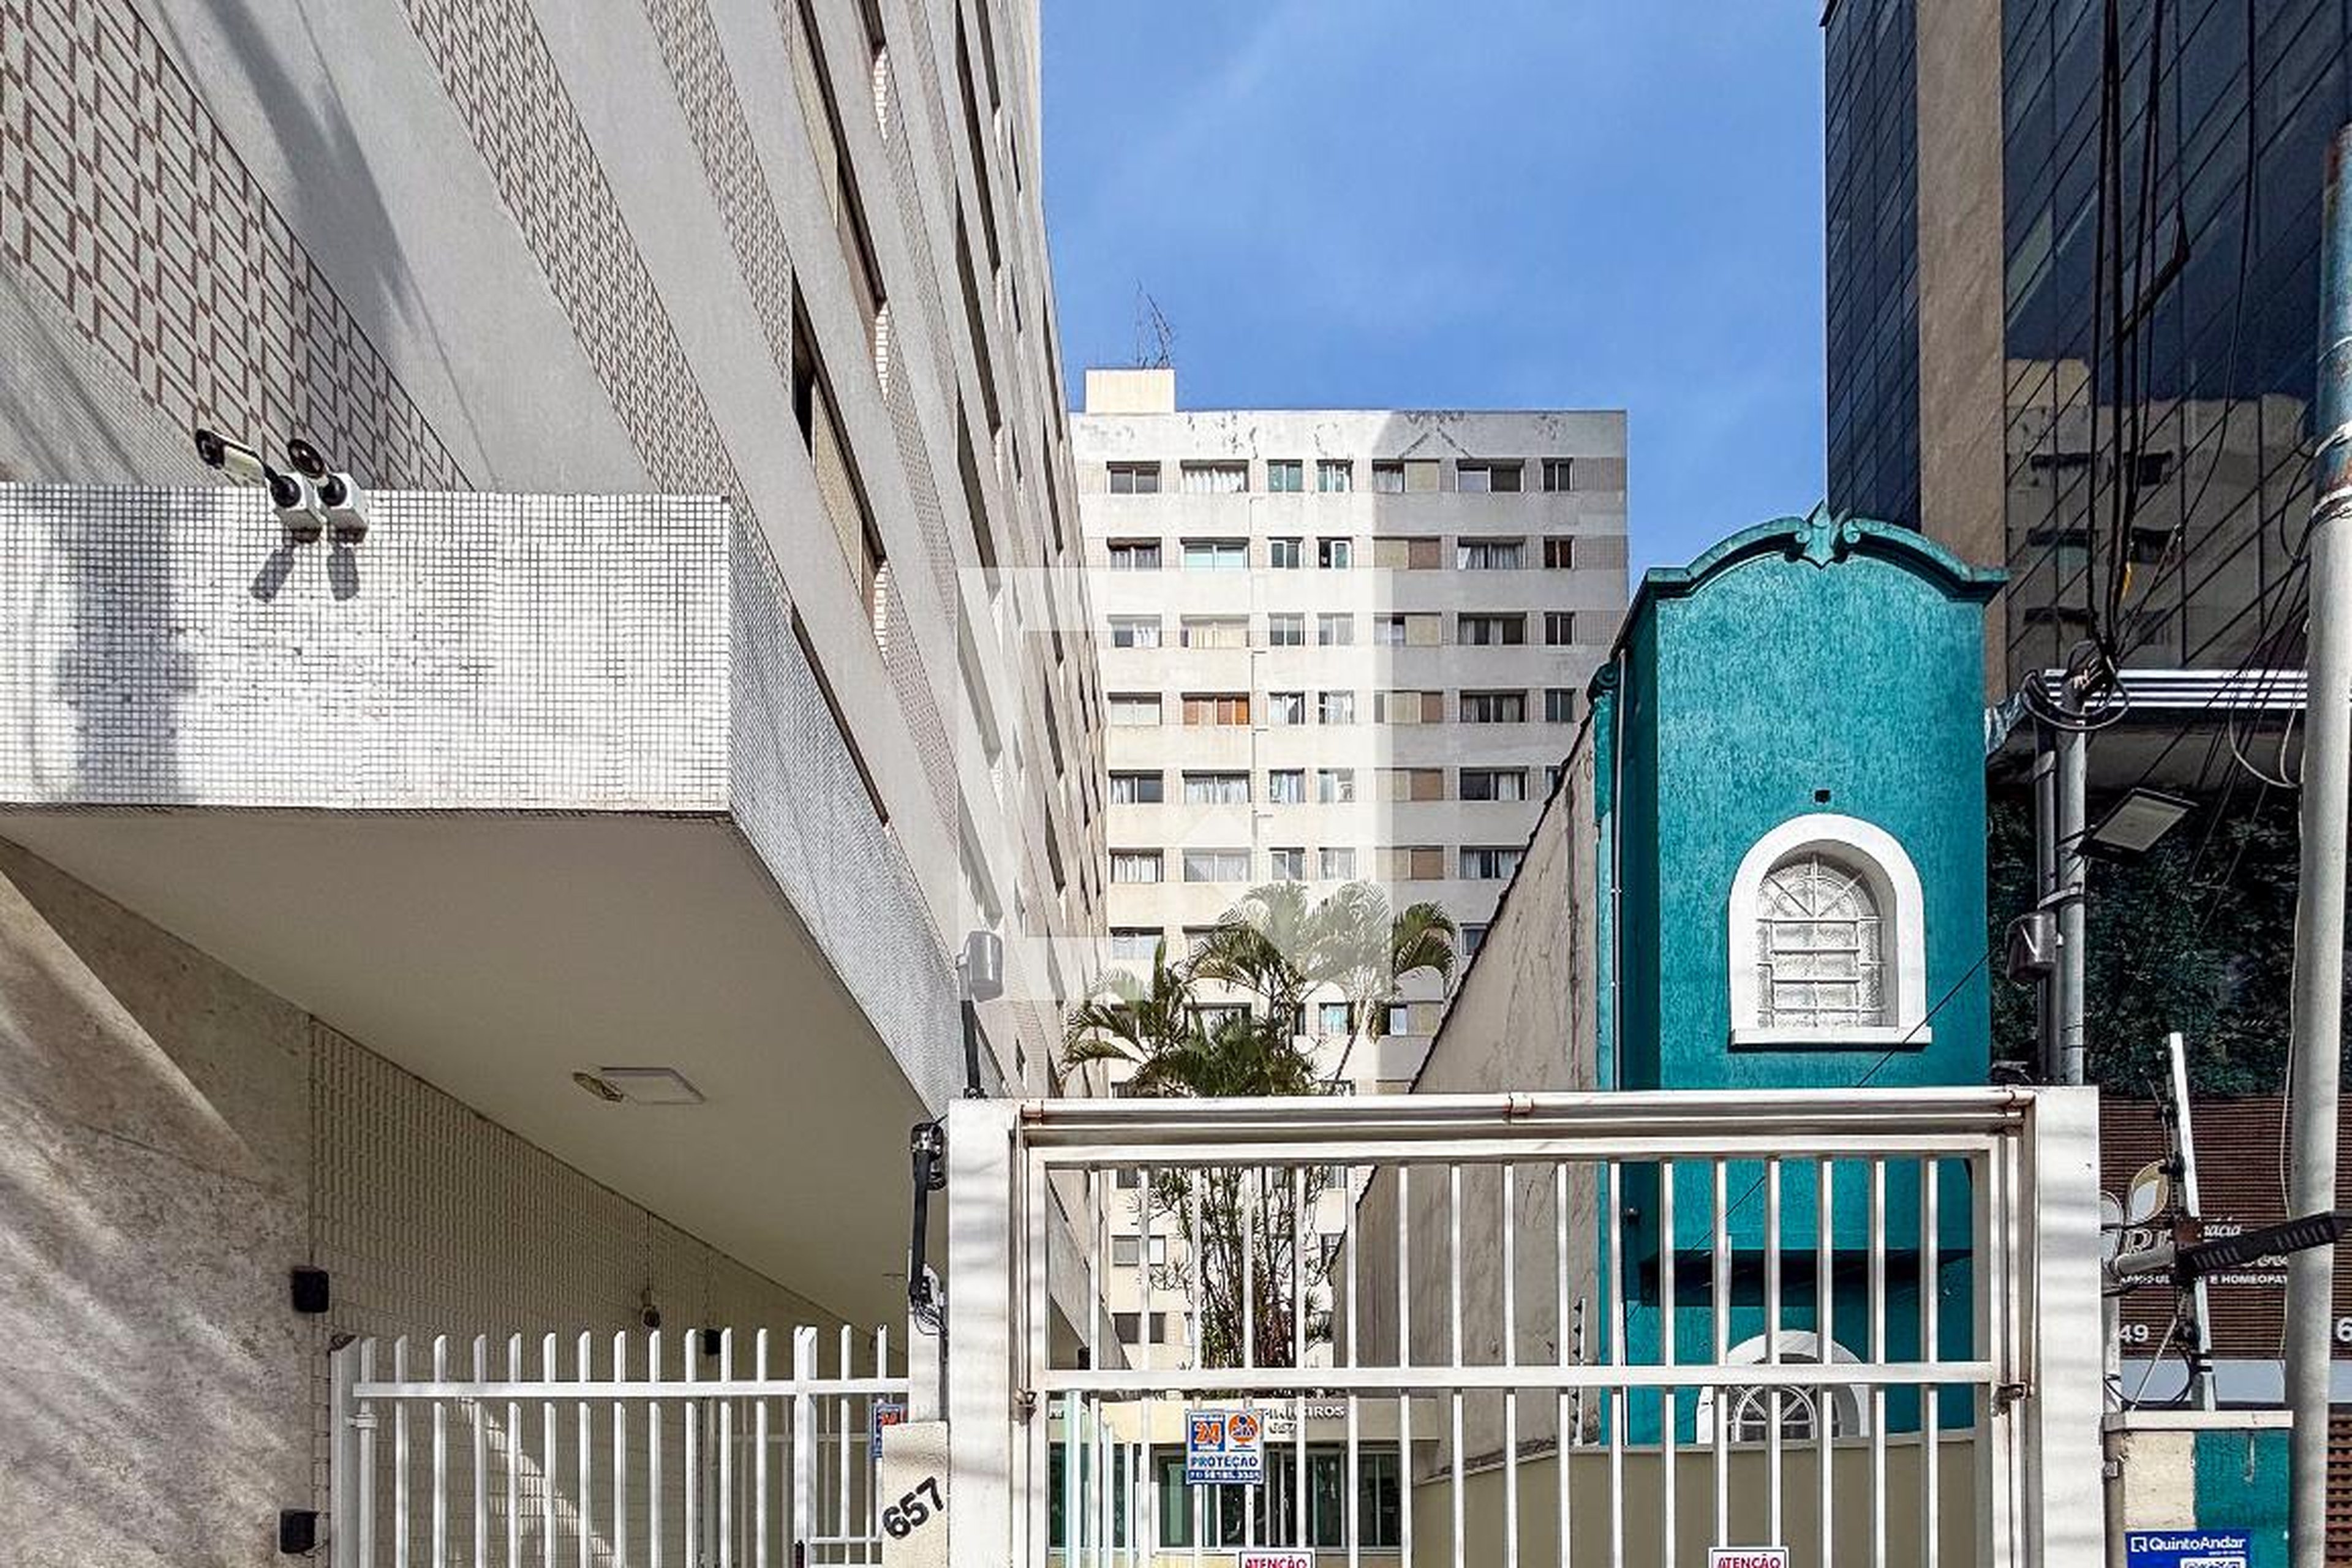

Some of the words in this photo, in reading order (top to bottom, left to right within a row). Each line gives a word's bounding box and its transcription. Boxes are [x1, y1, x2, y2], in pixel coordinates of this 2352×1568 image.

[2221, 1274, 2288, 1284] HOMEOPAT
[2119, 1324, 2149, 1343] 49
[1191, 1453, 1259, 1468] PROTEÇÃO
[882, 1476, 944, 1540] 657
[2149, 1536, 2247, 1551] QuintoAndar
